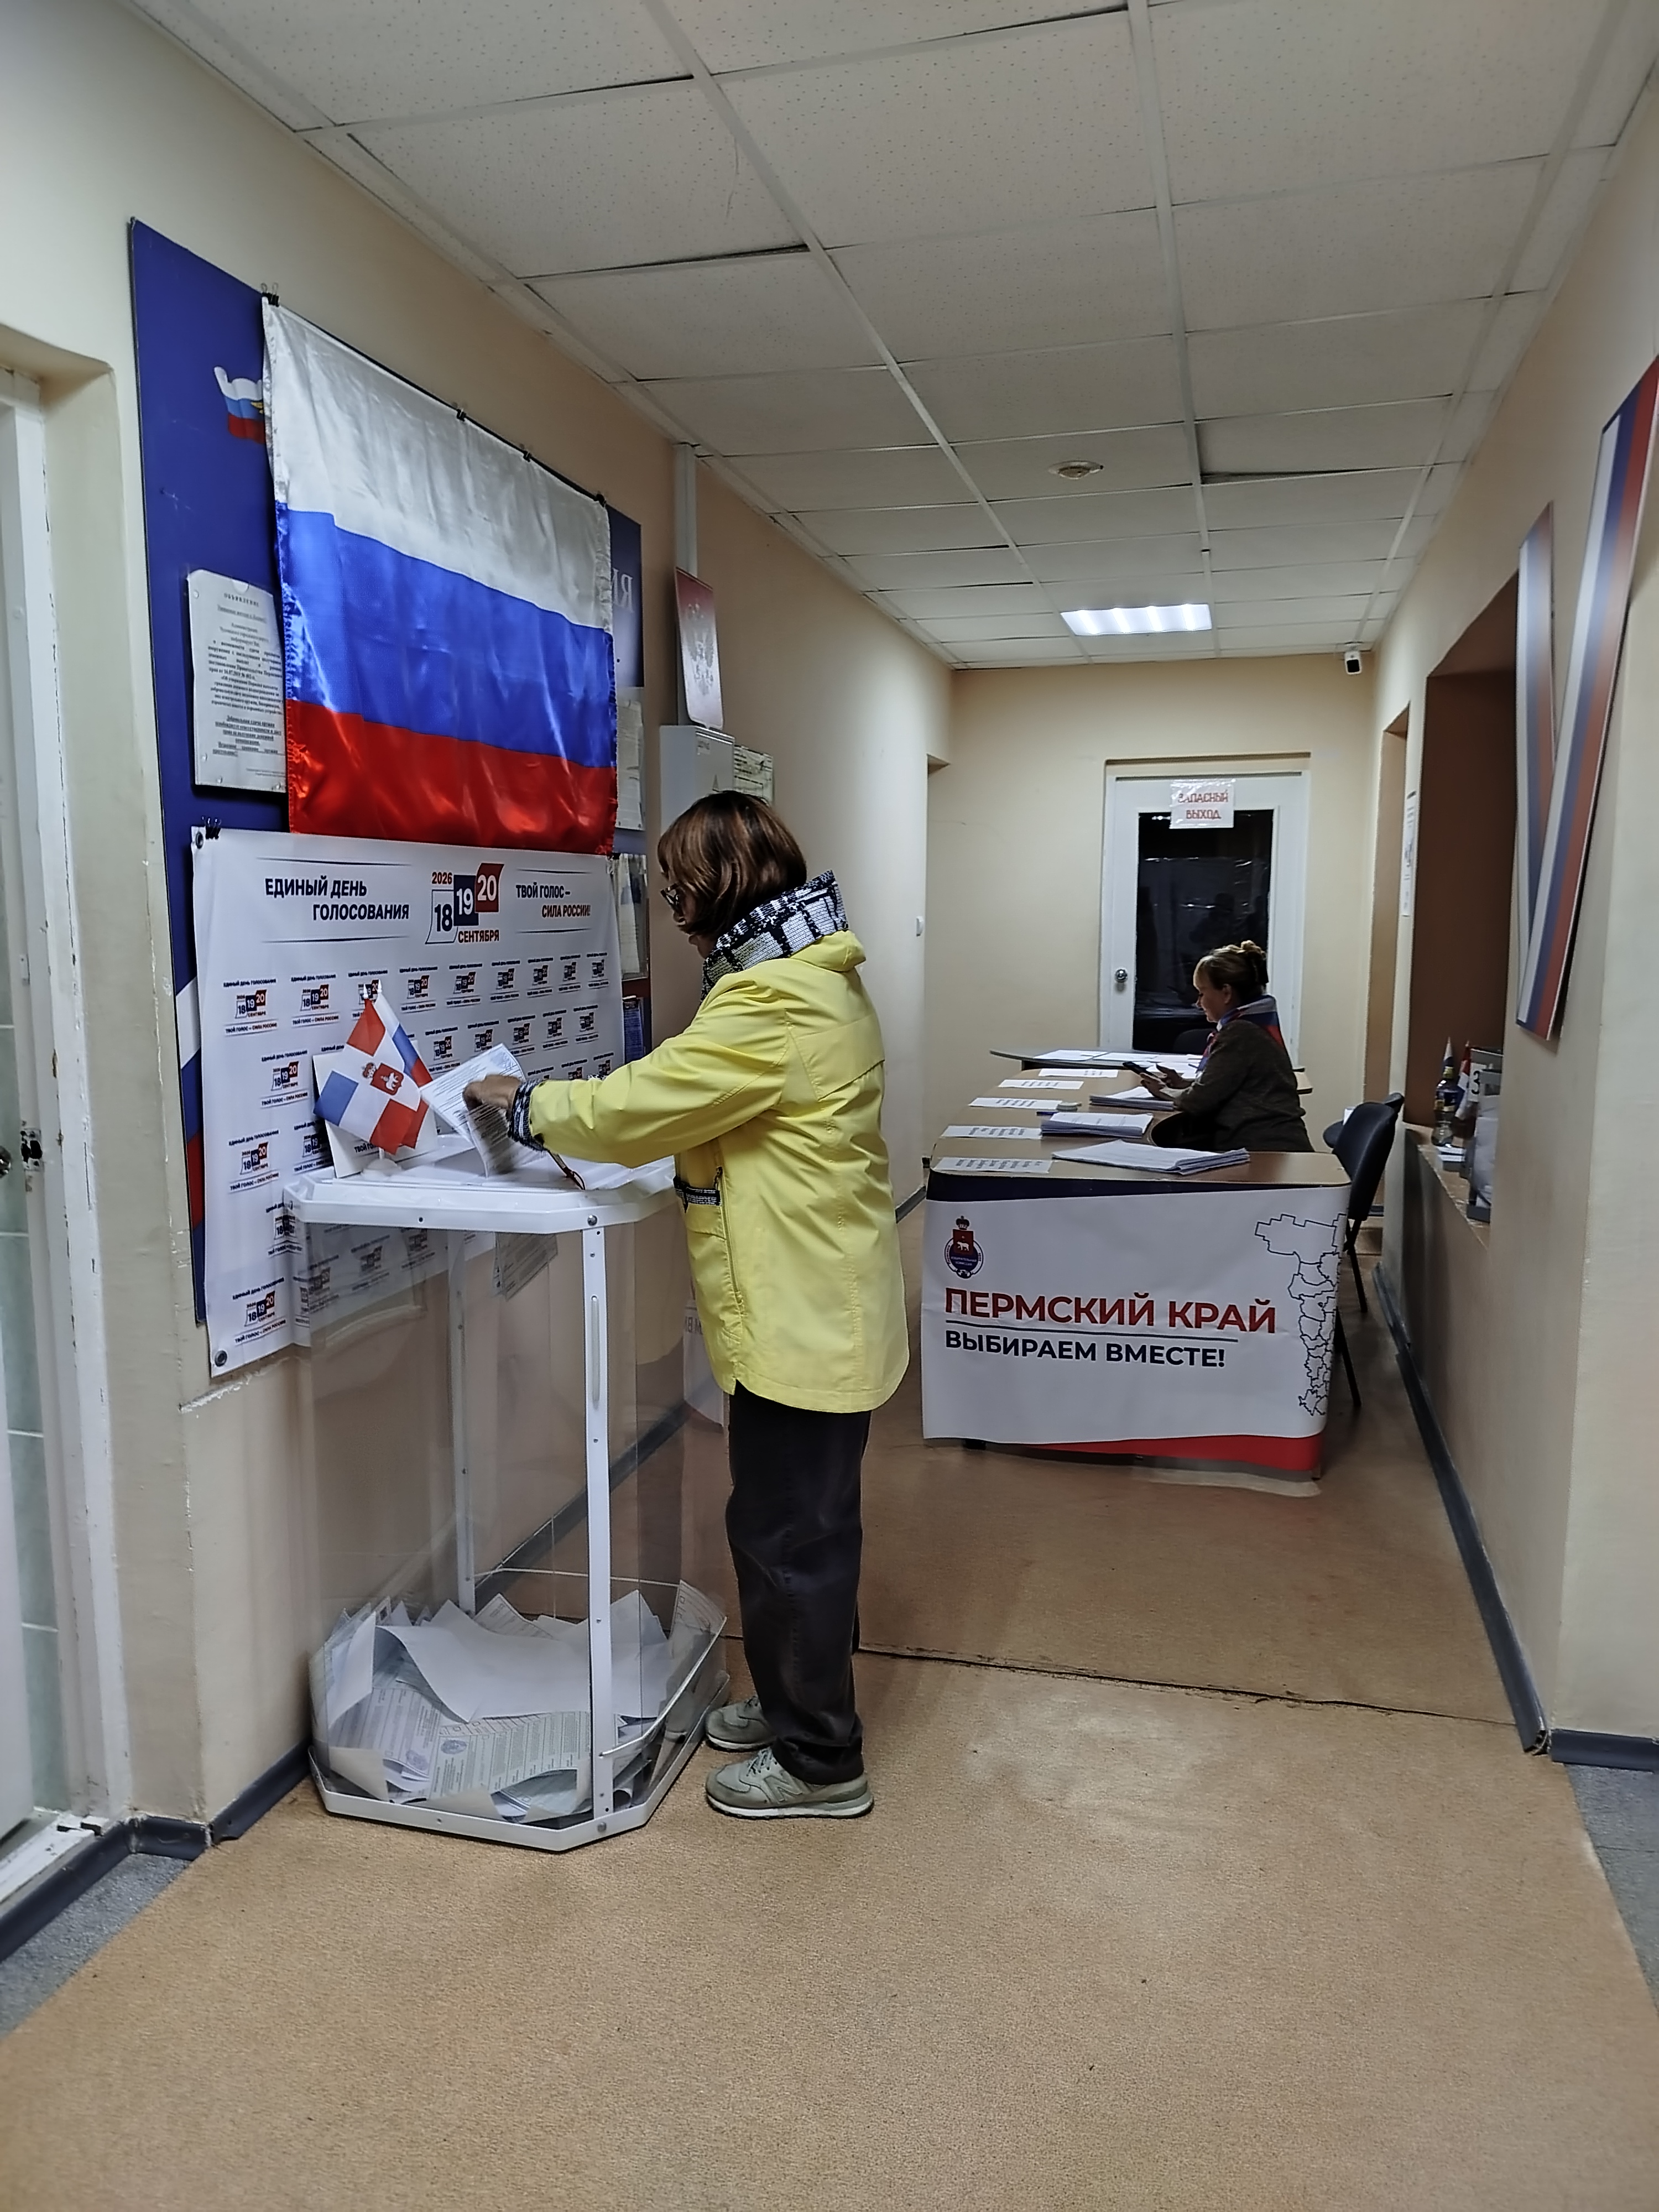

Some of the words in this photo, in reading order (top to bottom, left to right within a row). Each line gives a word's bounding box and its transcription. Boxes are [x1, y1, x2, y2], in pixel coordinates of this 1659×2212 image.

[1186, 810, 1221, 820] ВЫХОД
[265, 875, 328, 899] ЕДИНЫЙ
[330, 880, 367, 899] ДЕНЬ
[432, 872, 452, 884] 2026
[516, 882, 538, 899] ТВОЙ
[539, 885, 564, 899] ГОЛОС
[312, 904, 410, 920] ГОЛОСОВАНИЯ
[434, 904, 452, 932] 18
[456, 888, 473, 915] 19
[477, 875, 497, 901] 20
[542, 904, 562, 918] СИЛА
[458, 929, 499, 943] СЕНТЯБРЯ
[421, 978, 427, 987] 20
[238, 1005, 246, 1014] 18
[247, 999, 254, 1008] 19
[256, 993, 264, 1003] 20
[303, 998, 310, 1008] 18
[312, 993, 319, 1001] 19
[320, 988, 327, 997] 20
[274, 1077, 281, 1087] 18
[282, 1071, 288, 1080] 19
[289, 1065, 296, 1074] 20
[243, 1160, 251, 1170] 18
[252, 1154, 258, 1163] 19
[259, 1146, 266, 1156] 20
[305, 1144, 311, 1153] 18
[248, 1312, 257, 1322] 18
[258, 1303, 265, 1313] 19
[267, 1295, 274, 1306] 20
[945, 1287, 1155, 1327] ПЕРМСКИЙ
[1168, 1298, 1276, 1334] КРАЙ
[946, 1330, 1097, 1362] ВЫБИРАЕМ
[1106, 1343, 1225, 1368] ВМЕСТЕ!
